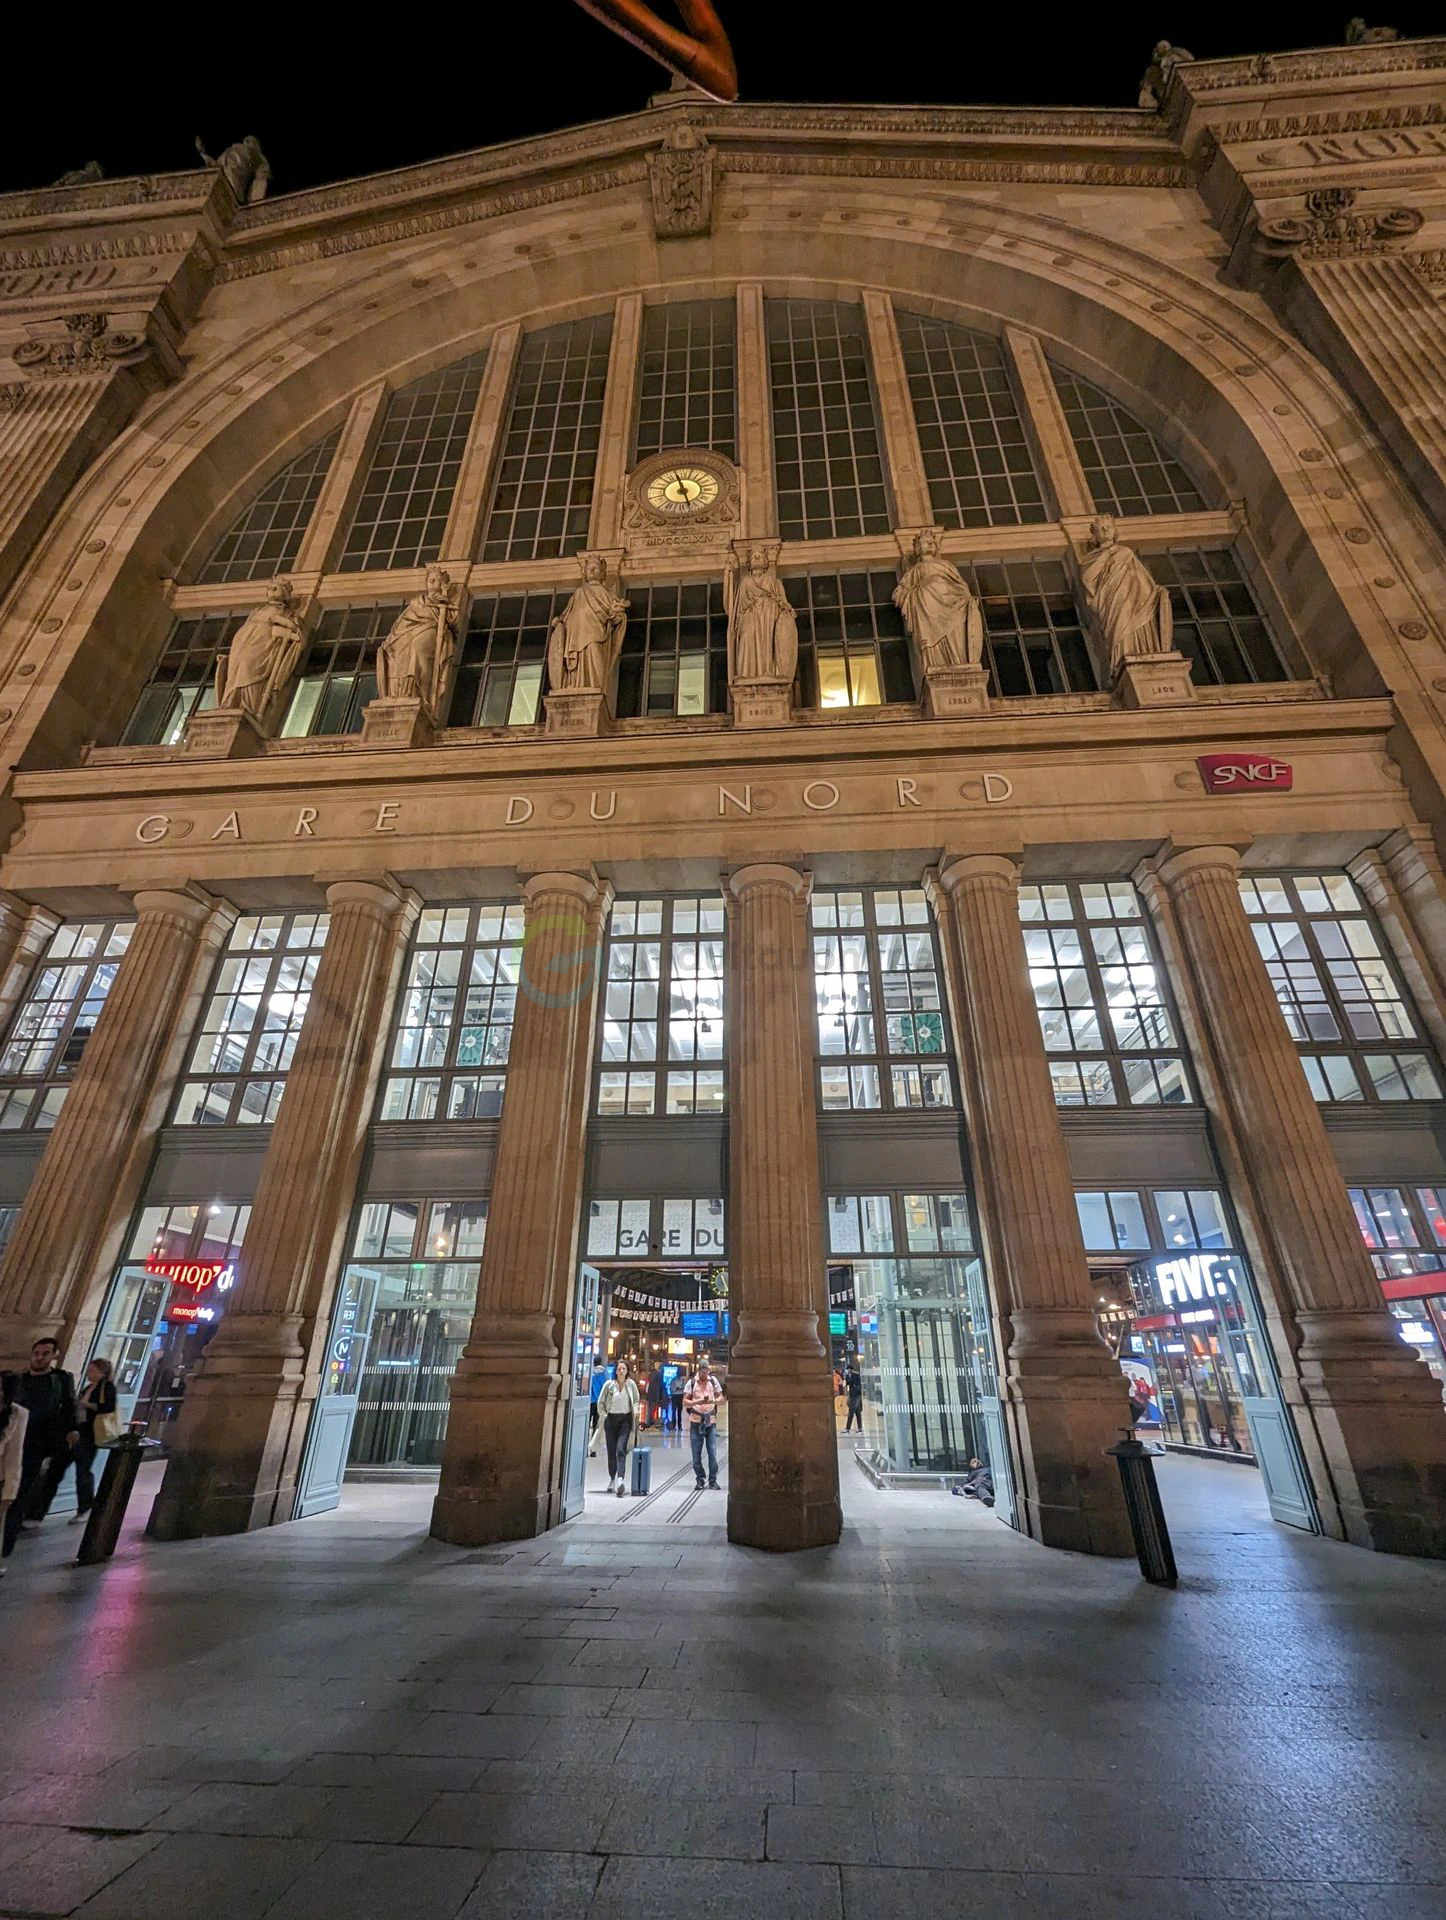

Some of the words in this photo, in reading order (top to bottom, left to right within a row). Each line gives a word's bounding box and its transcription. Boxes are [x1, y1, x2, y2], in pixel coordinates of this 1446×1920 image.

[1213, 764, 1289, 784] SNCF
[136, 803, 402, 843] GARE
[505, 791, 617, 826] DU
[719, 773, 1014, 815] NORD
